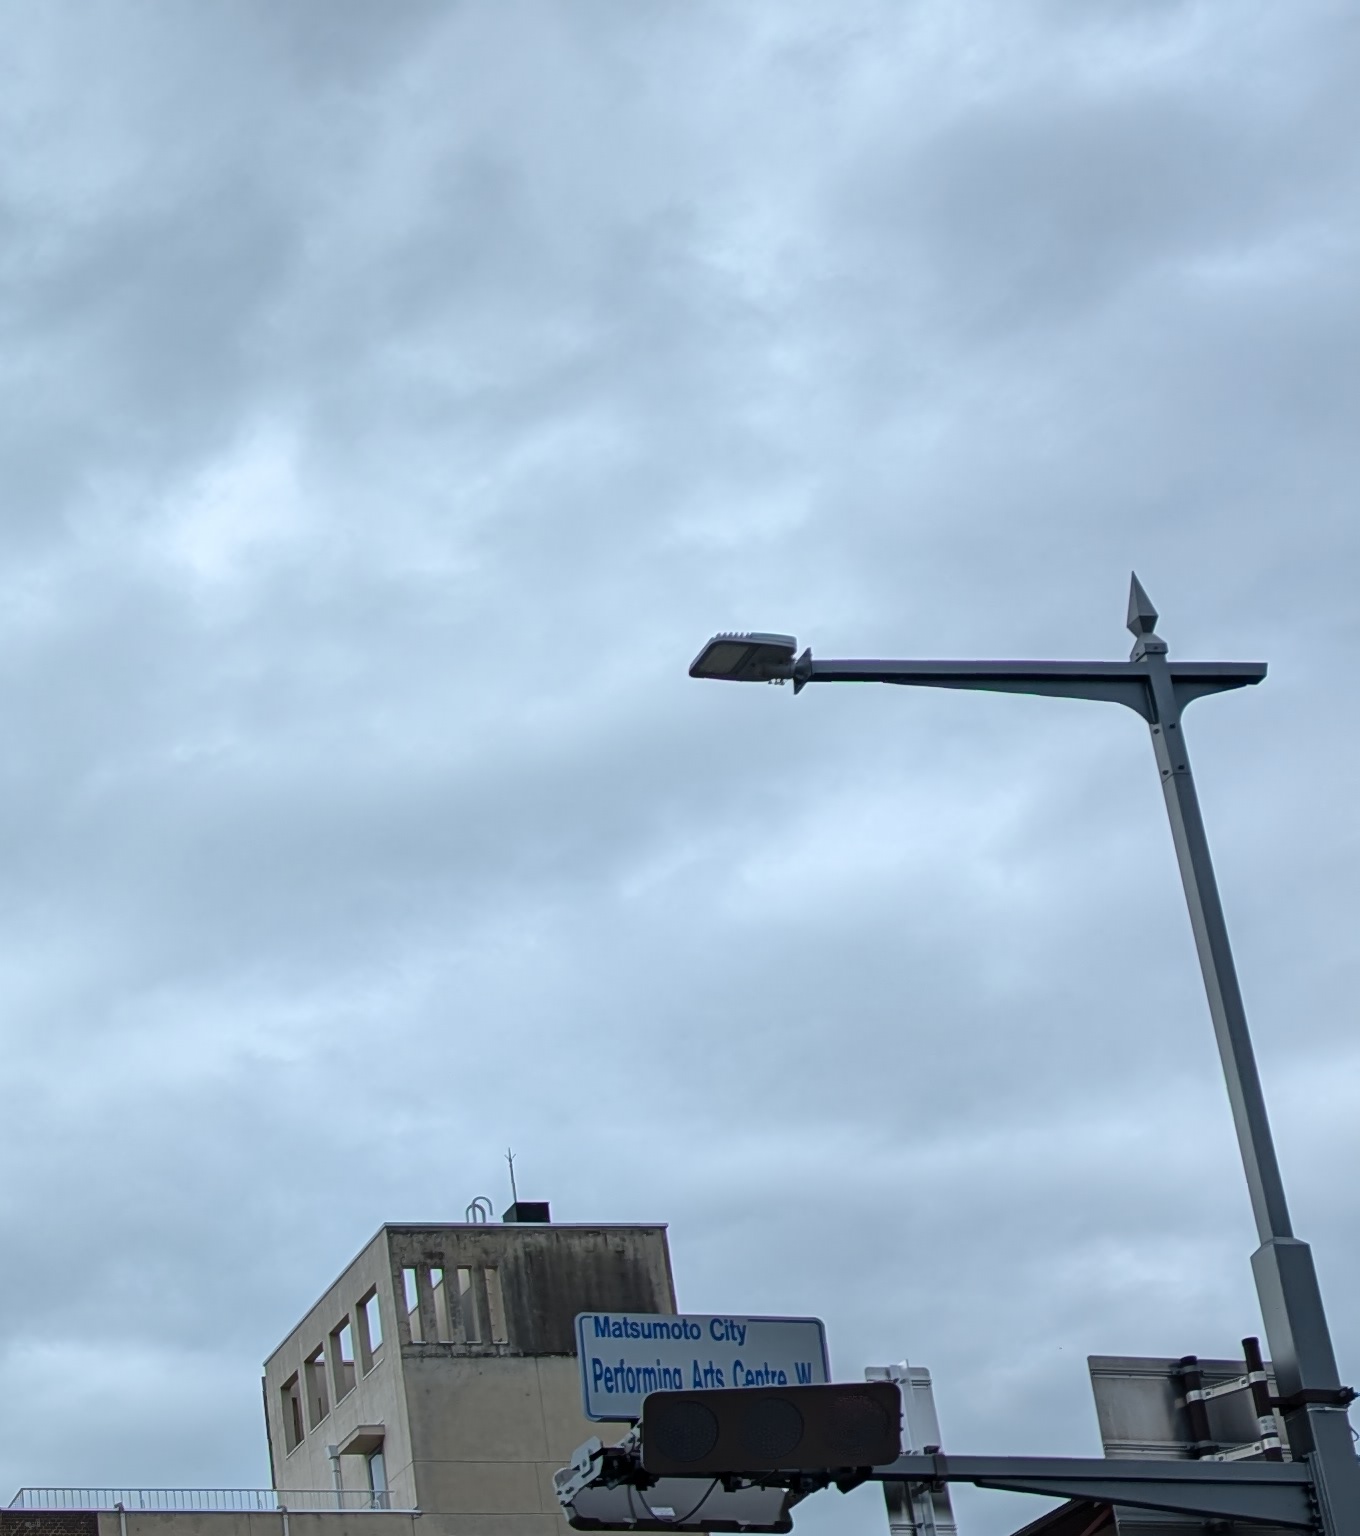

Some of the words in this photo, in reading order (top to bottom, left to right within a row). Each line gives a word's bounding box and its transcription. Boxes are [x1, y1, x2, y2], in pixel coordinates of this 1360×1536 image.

[594, 1316, 701, 1340] Matsumoto
[710, 1317, 747, 1346] City
[591, 1357, 682, 1393] Performing
[693, 1359, 724, 1388] Arts
[733, 1359, 787, 1387] Centre
